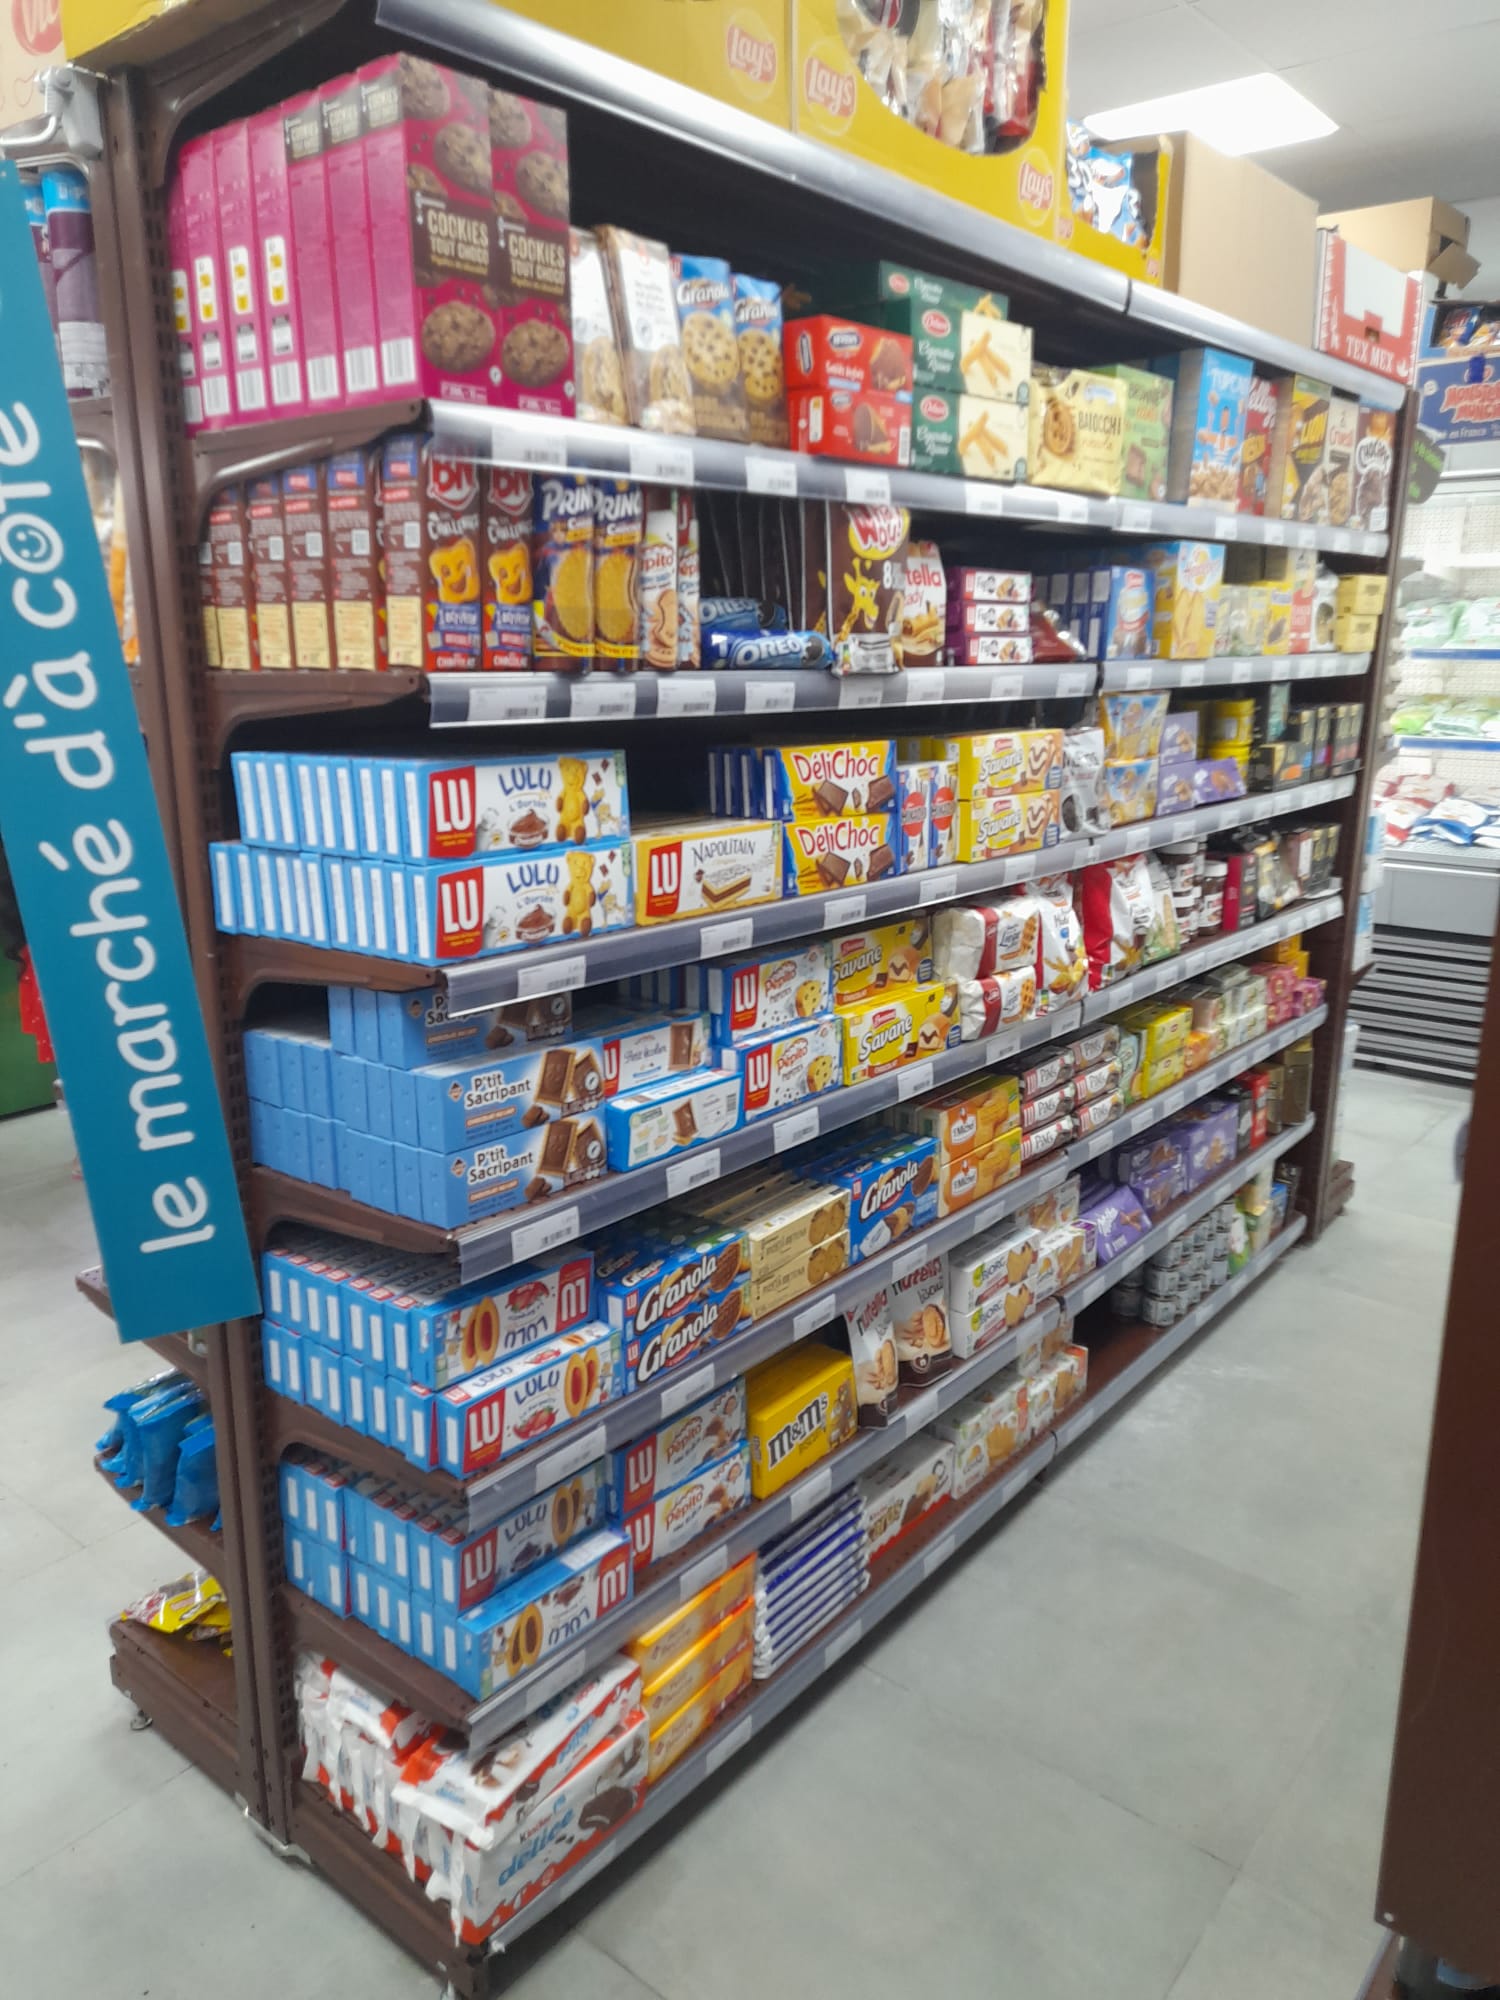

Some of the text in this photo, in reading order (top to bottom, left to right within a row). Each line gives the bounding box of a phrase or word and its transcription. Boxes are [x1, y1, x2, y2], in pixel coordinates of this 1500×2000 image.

[428, 209, 488, 242] COOKIES
[431, 236, 455, 257] TOUT
[509, 234, 565, 266] COOKIES
[511, 258, 532, 278] TOUT
[677, 281, 731, 306] Granola
[1346, 336, 1395, 373] TEX MEX
[905, 565, 942, 587] tella
[736, 637, 799, 665] OREO
[2, 651, 116, 790] d'à
[498, 766, 553, 797] LULU
[793, 750, 879, 782] DéliChoc
[980, 751, 1023, 781] Savane
[432, 778, 473, 833] LU
[797, 821, 880, 857] DéliChoc
[977, 811, 1021, 844] Savane
[506, 863, 559, 894] LULU
[651, 851, 679, 897] LU
[441, 879, 480, 934] LU
[832, 946, 882, 985] Savane
[38, 818, 195, 1152] marché
[734, 973, 756, 1013] LU
[860, 1014, 912, 1062] Savane
[474, 1073, 503, 1091] P'tit
[603, 1047, 617, 1081] U
[748, 1052, 769, 1092] LU
[466, 1080, 531, 1107] Sacripant
[469, 1153, 534, 1183] Sacripant
[477, 1147, 506, 1166] P'tit
[860, 1160, 918, 1221] Granola
[140, 1176, 215, 1253] le
[636, 1256, 717, 1332] Granola
[893, 1257, 942, 1296] nutella
[561, 1276, 588, 1323] LU
[504, 1316, 549, 1350] LULU
[638, 1303, 719, 1383] Granola
[513, 1370, 560, 1404] LULU
[469, 1401, 500, 1453] LU
[628, 1445, 653, 1494] LU
[504, 1503, 547, 1542] LULU
[463, 1539, 493, 1590] LU
[601, 1561, 627, 1609] LU
[549, 1607, 591, 1646] LULU
